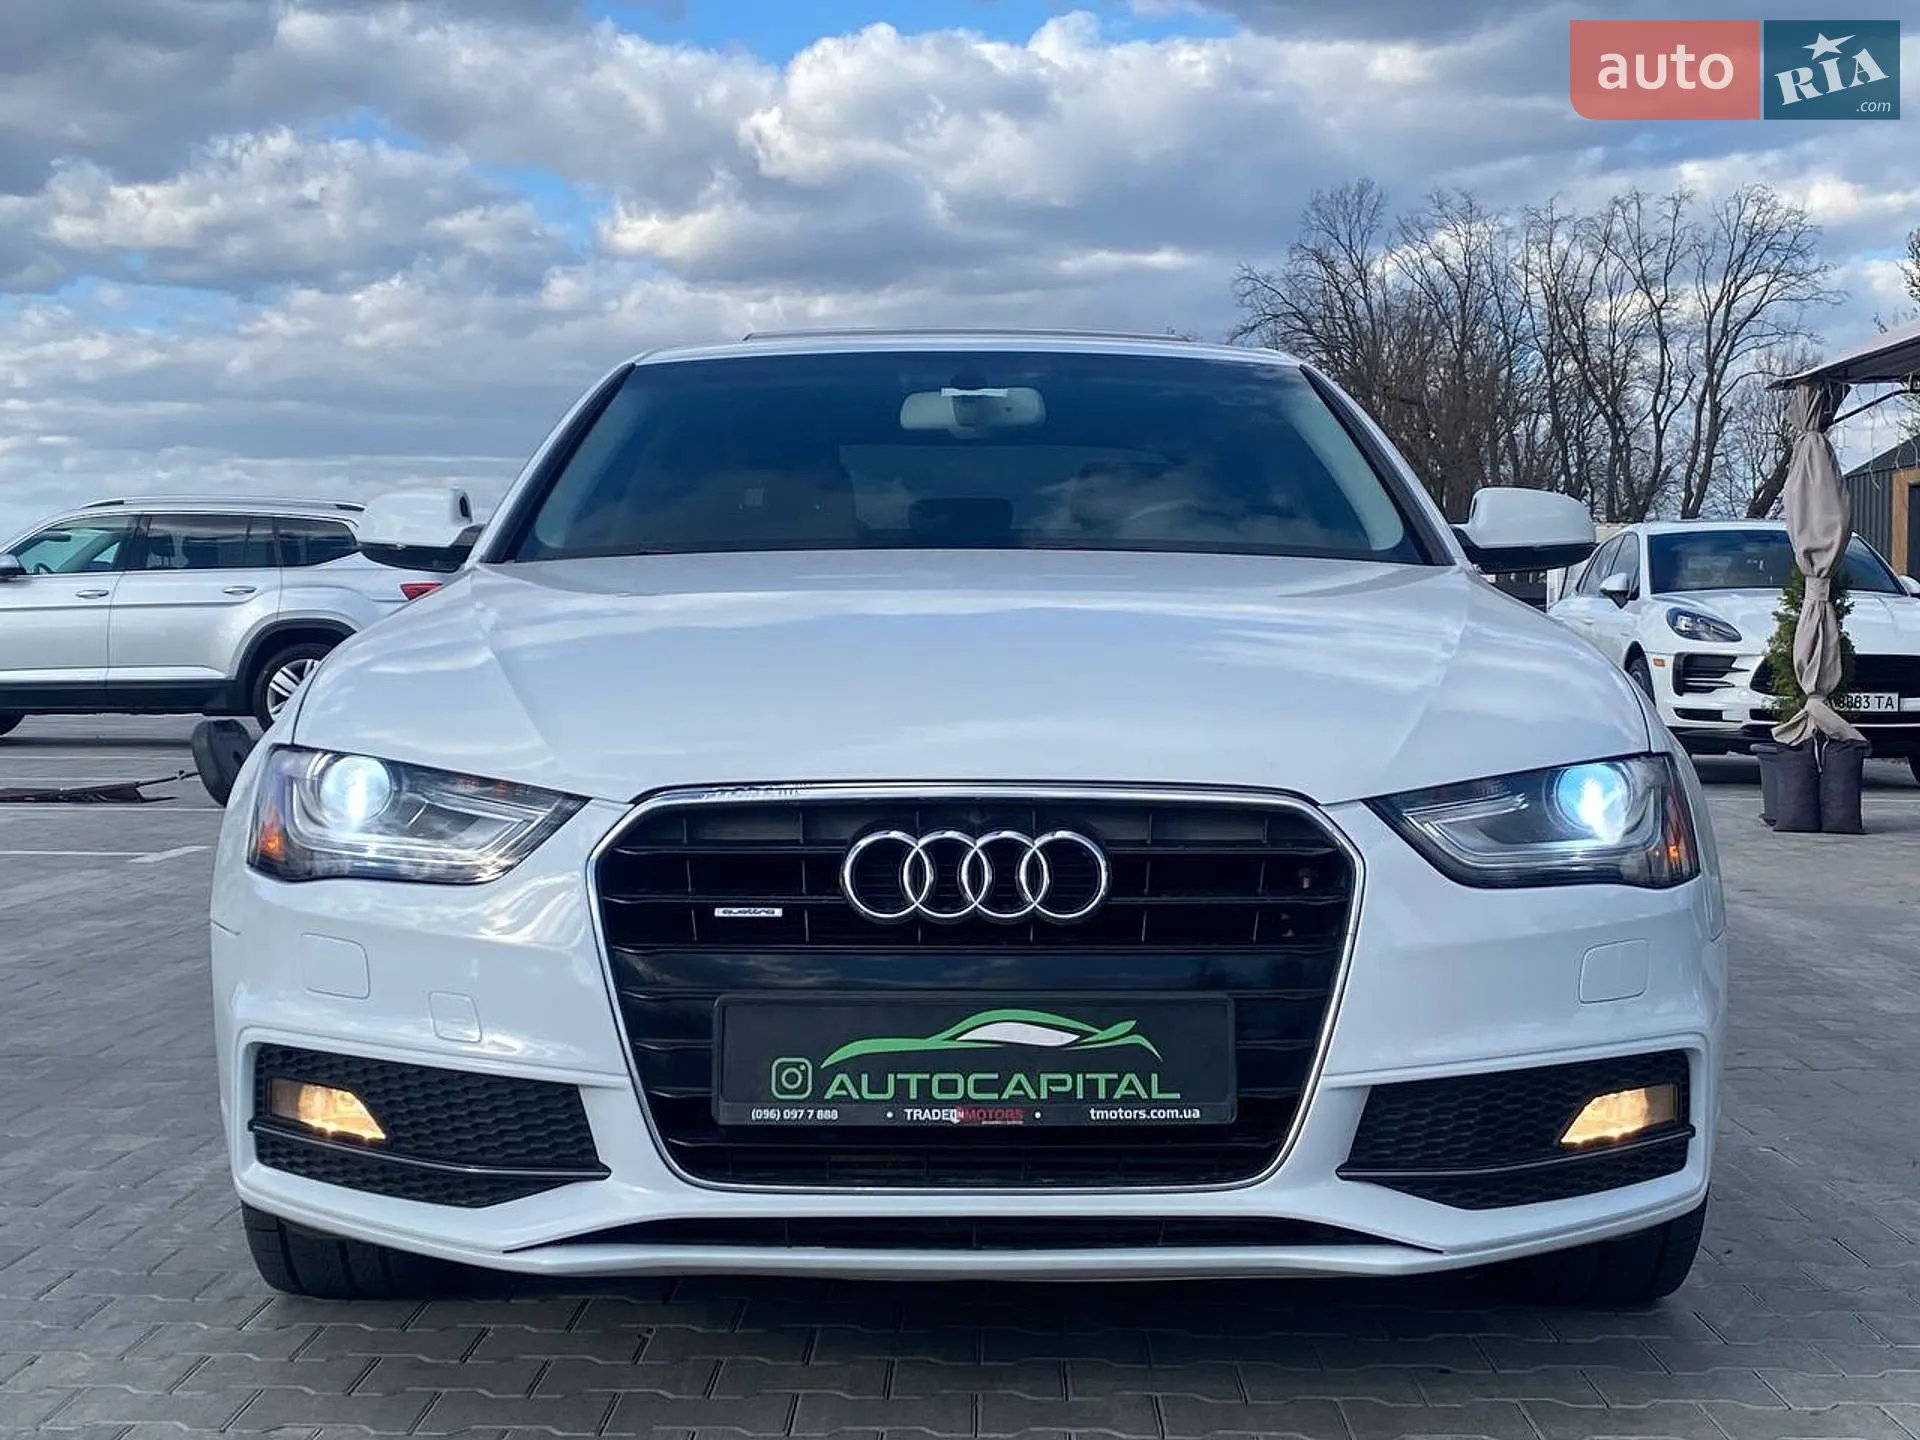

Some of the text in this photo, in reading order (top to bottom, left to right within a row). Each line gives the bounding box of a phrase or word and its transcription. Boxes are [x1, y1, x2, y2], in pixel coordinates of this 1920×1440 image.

[1874, 695, 1894, 709] TA
[824, 1073, 1181, 1100] AUTOCAPITAL
[1089, 1107, 1201, 1120] tmotors.com.ua
